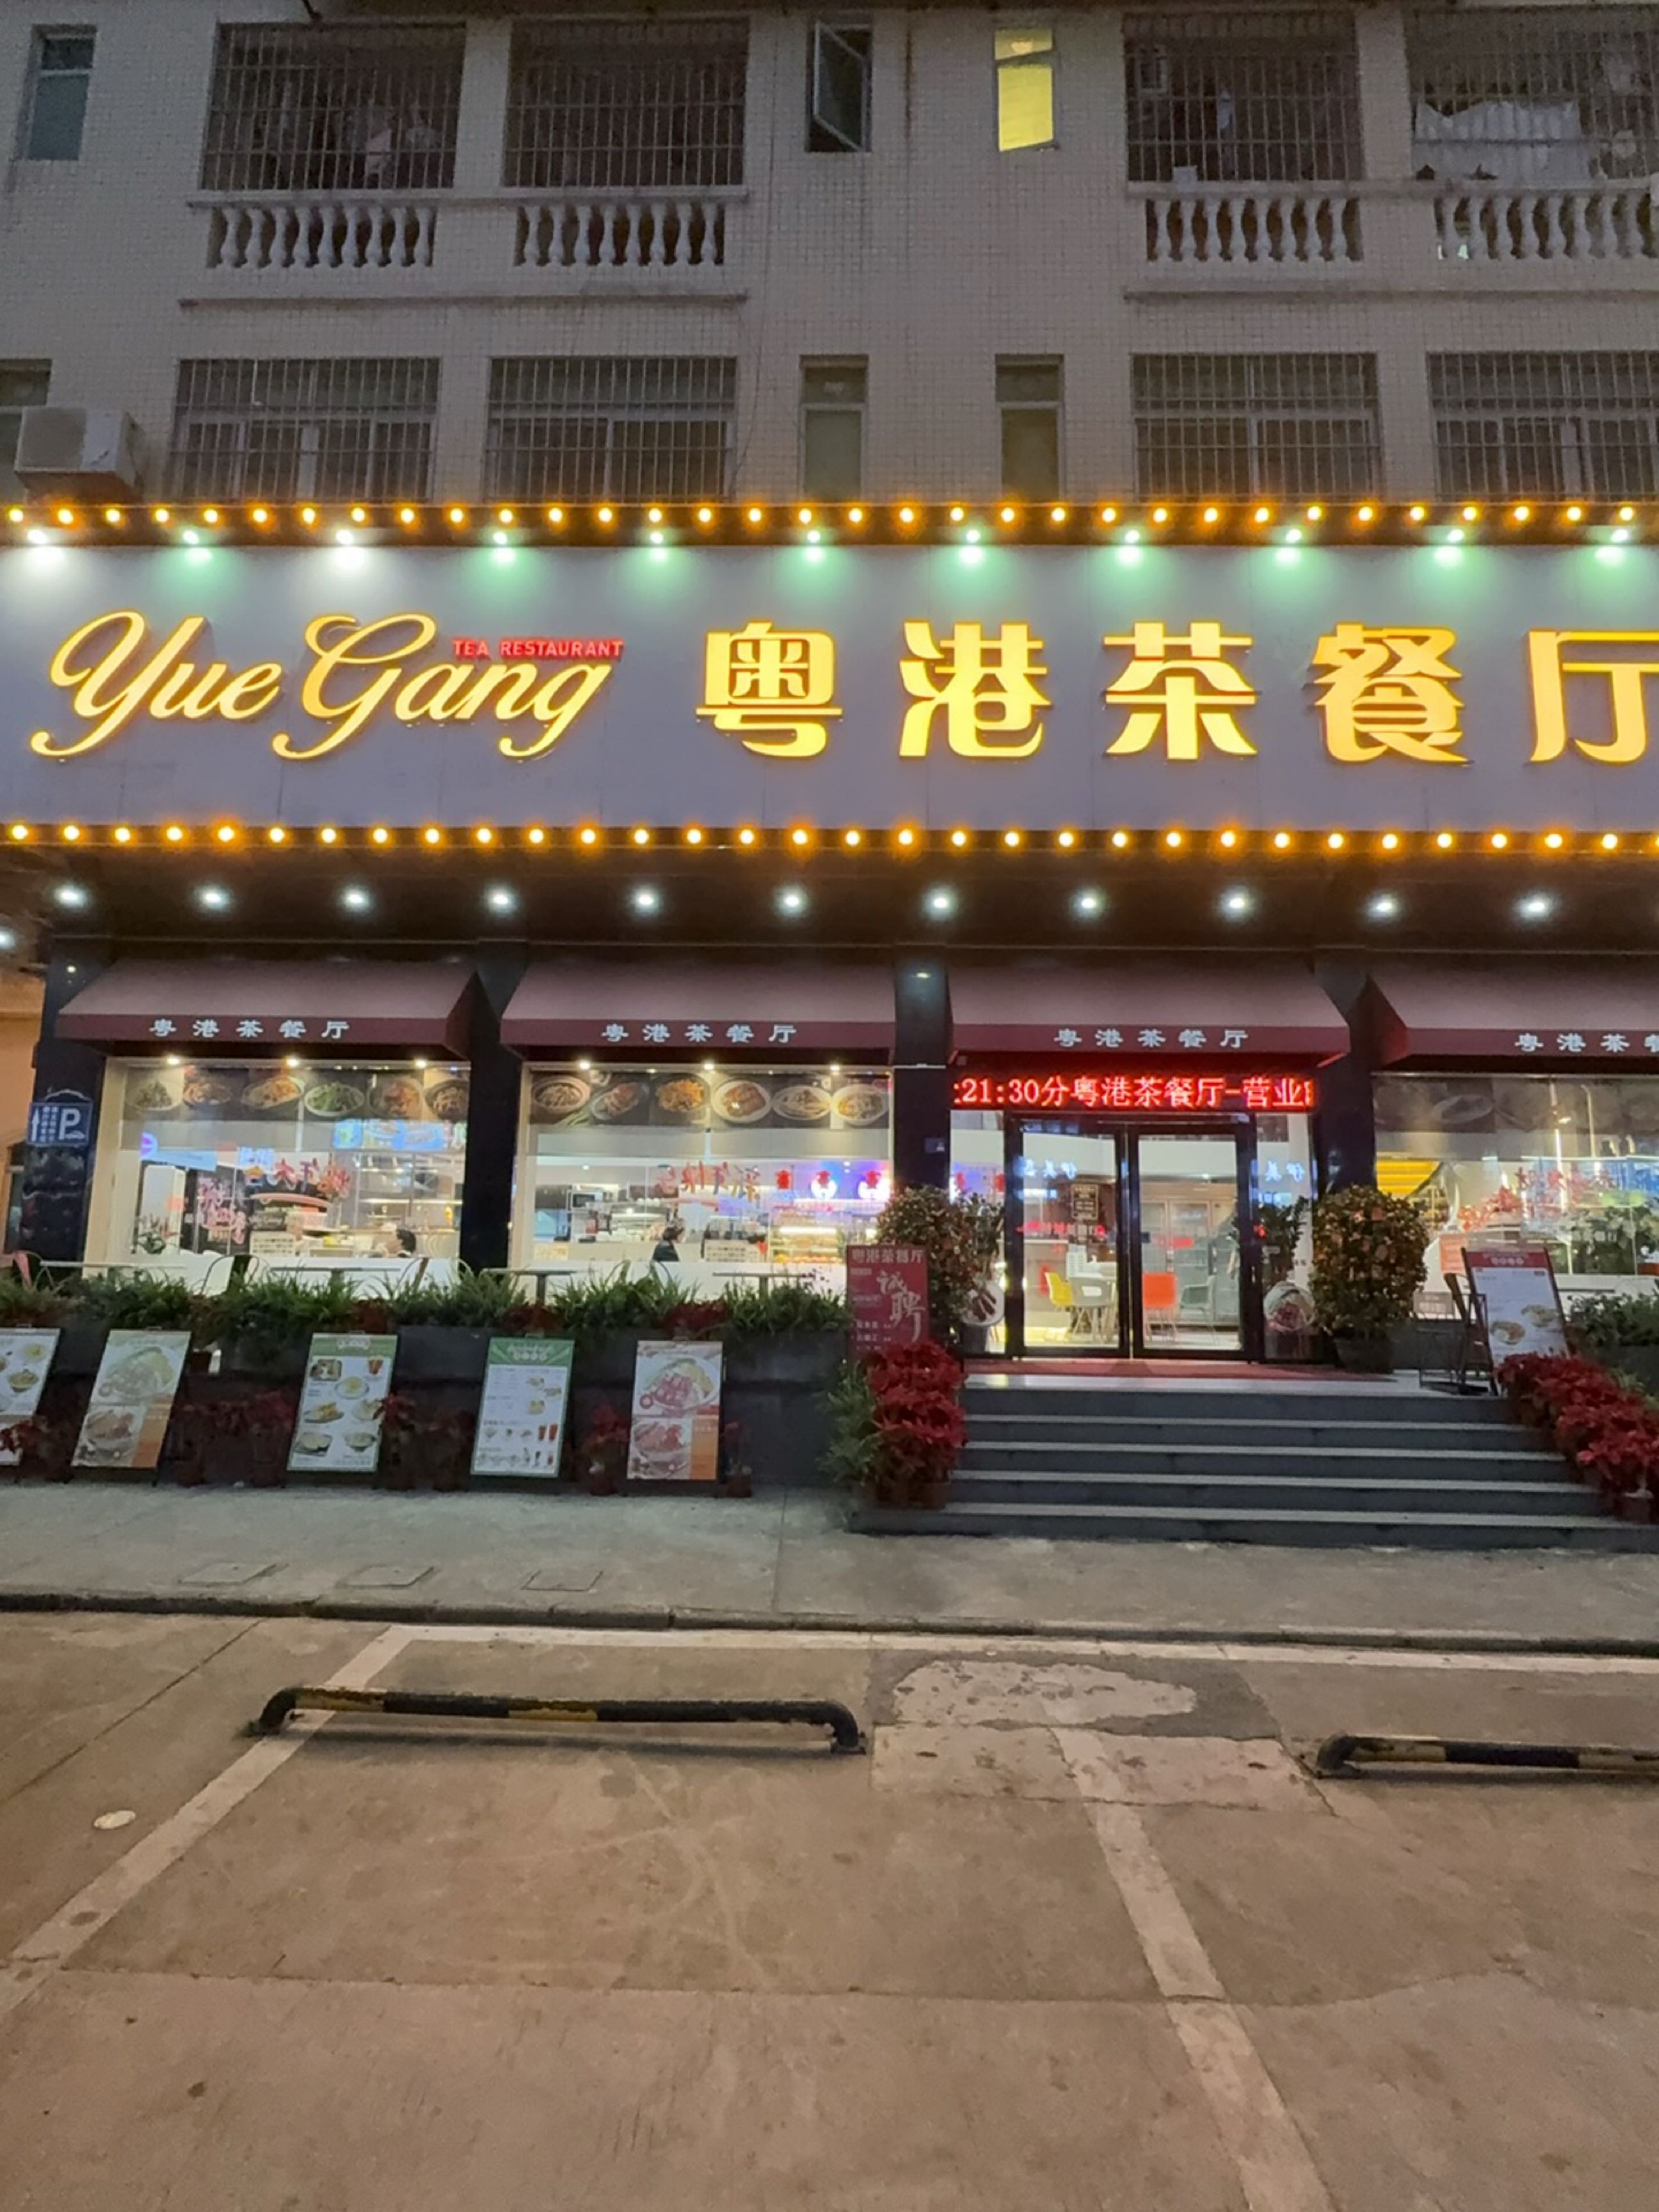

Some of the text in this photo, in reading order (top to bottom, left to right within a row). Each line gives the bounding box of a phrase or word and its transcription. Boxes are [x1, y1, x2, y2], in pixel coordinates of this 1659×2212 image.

[453, 639, 623, 658] TEA RESTAURANT
[30, 610, 613, 760] Yue Gang
[695, 620, 1659, 765] 粤港茶餐厅
[149, 1018, 349, 1039] 粤港茶餐厅
[601, 1023, 797, 1044] 粤港茶餐厅
[1054, 1029, 1249, 1049] 粤港茶餐厅
[58, 1108, 81, 1140] P
